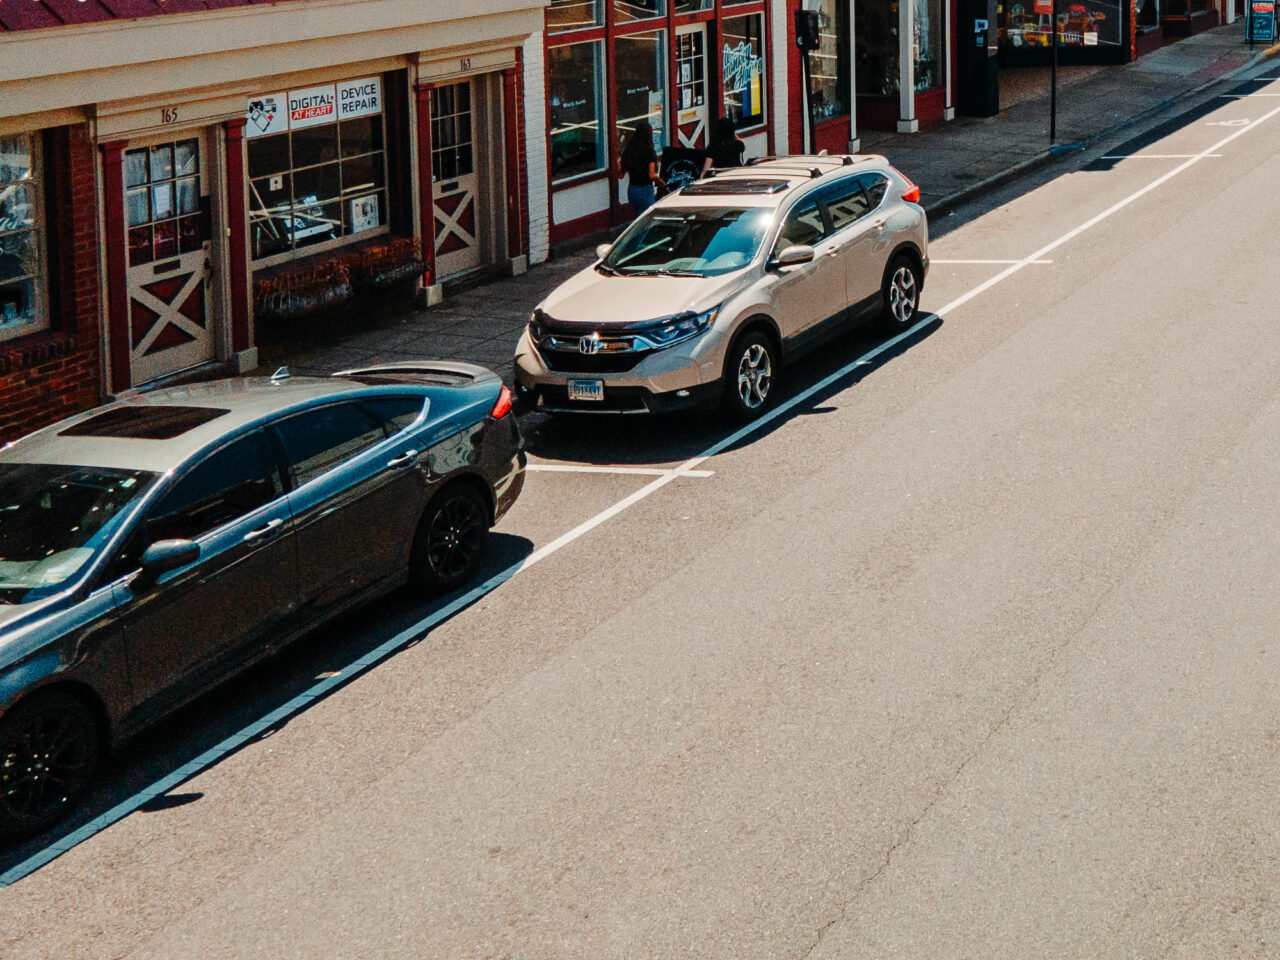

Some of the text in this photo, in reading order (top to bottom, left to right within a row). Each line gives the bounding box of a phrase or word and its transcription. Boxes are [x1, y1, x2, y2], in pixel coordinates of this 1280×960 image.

[460, 58, 472, 72] 163
[341, 84, 377, 100] DEVICE
[290, 94, 333, 111] DIGITAL
[342, 97, 378, 113] REPAIR
[161, 107, 178, 124] 165
[293, 105, 332, 120] AT HEART
